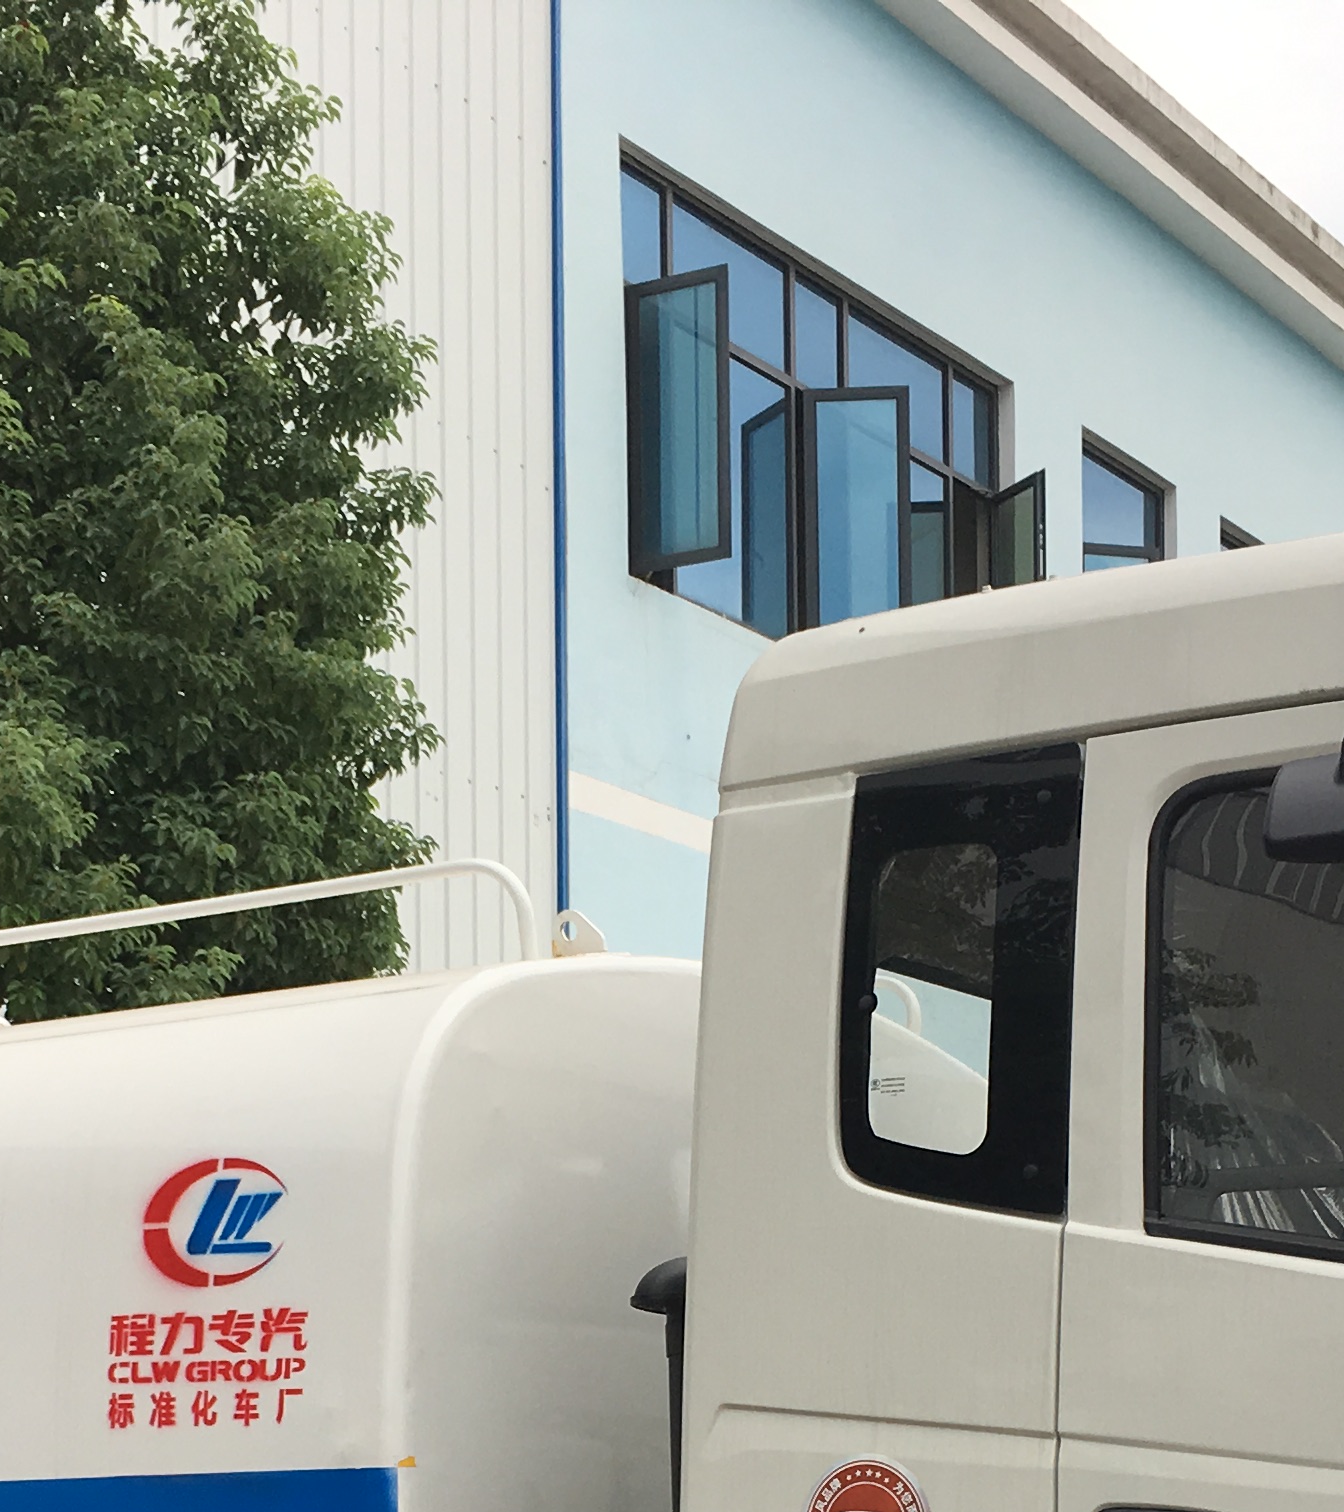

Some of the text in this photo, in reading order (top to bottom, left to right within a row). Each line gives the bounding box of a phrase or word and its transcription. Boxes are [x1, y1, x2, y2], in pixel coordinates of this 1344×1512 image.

[109, 1307, 309, 1357] 程力专汽
[108, 1358, 306, 1384] CLW GROUP
[108, 1388, 304, 1429] 标准化车厂
